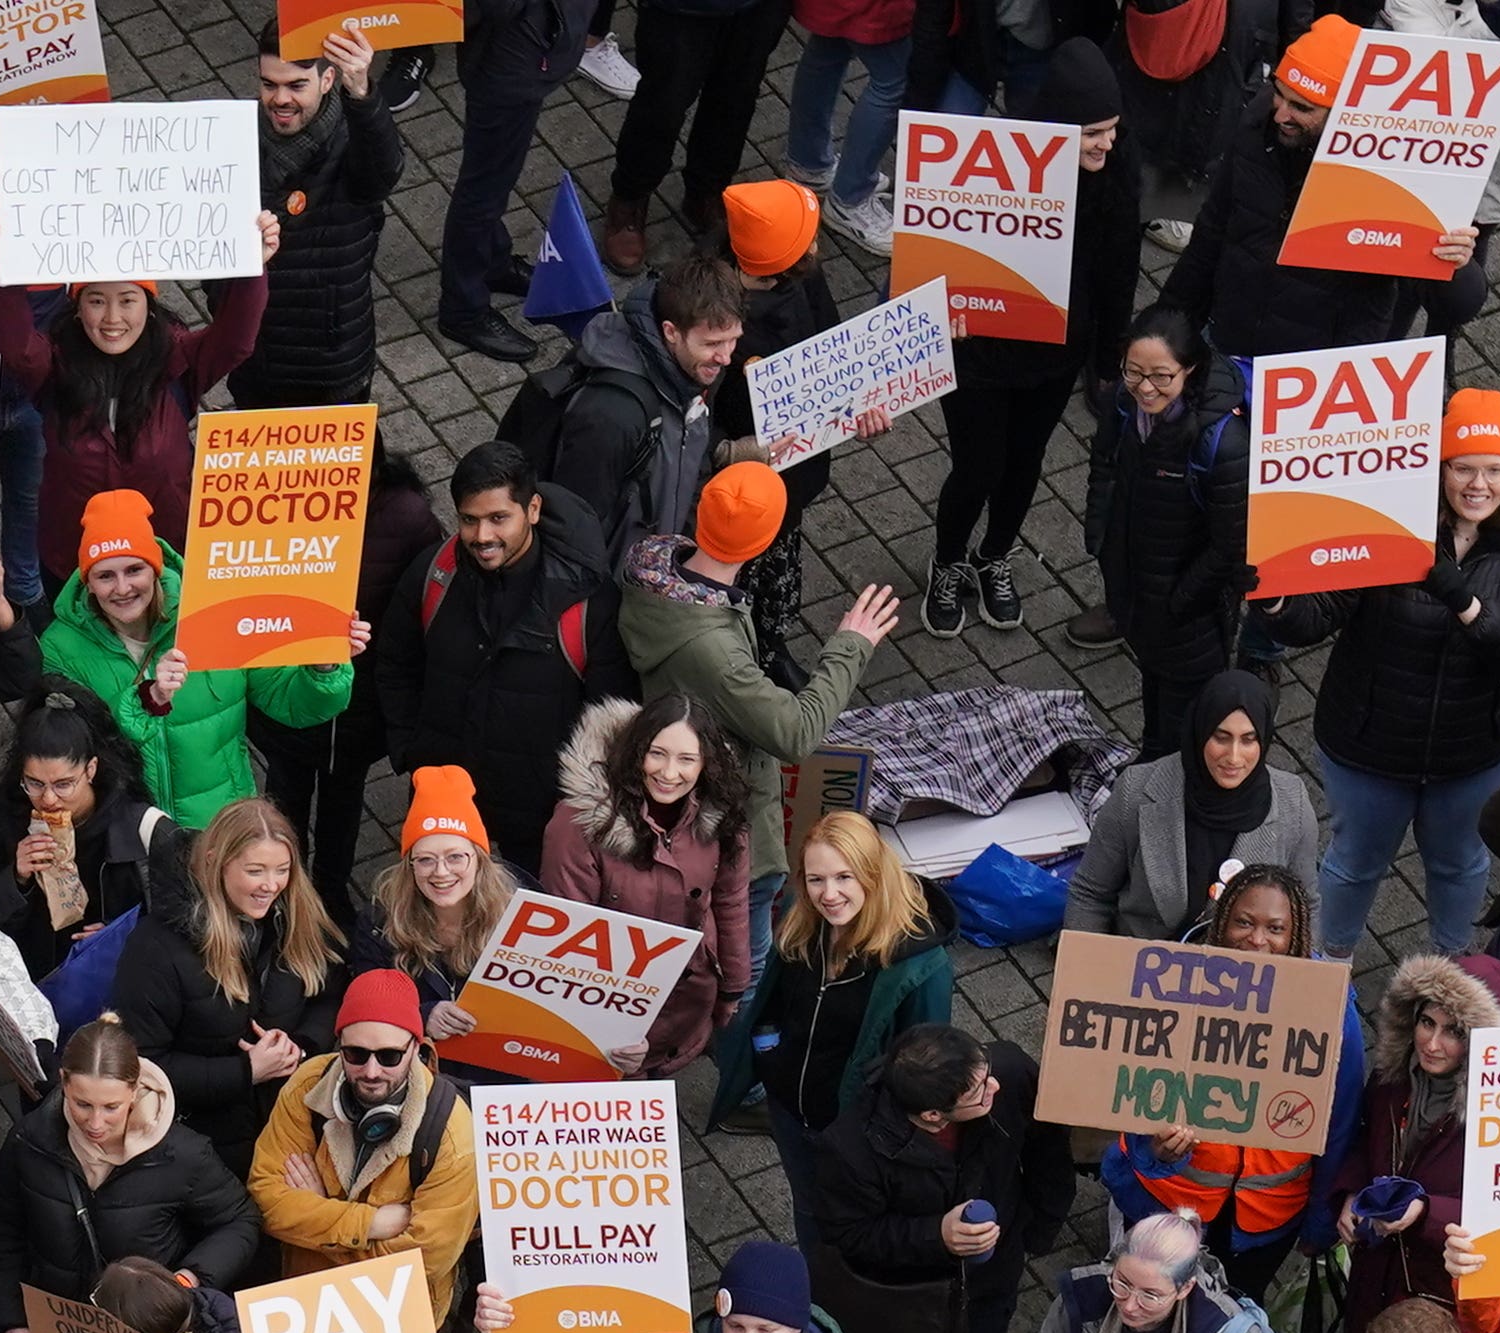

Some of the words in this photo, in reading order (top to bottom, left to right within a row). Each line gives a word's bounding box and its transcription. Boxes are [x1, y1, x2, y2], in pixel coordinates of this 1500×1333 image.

[56, 118, 105, 155] MY
[123, 116, 220, 154] HAIRCUT
[906, 124, 1069, 194] PAY
[2, 169, 56, 194] COST
[74, 168, 102, 194] ME
[116, 167, 170, 192] TWICE
[182, 164, 238, 194] WHAT
[905, 187, 1025, 209] RESTORATION
[1031, 199, 1065, 213] FOR
[11, 205, 31, 237] I
[40, 204, 86, 237] GET
[102, 203, 150, 238] PAID
[157, 202, 183, 237] TO
[197, 202, 227, 238] DO
[904, 204, 1063, 240] DOCTORS
[32, 241, 98, 276] YOUR
[117, 238, 237, 273] CAESAREAN
[968, 297, 1006, 313] BMA
[1059, 998, 1180, 1059] BETTER
[1192, 1015, 1273, 1069] HAVE
[1283, 1027, 1329, 1078] MY
[1111, 1064, 1260, 1133] MONEY
